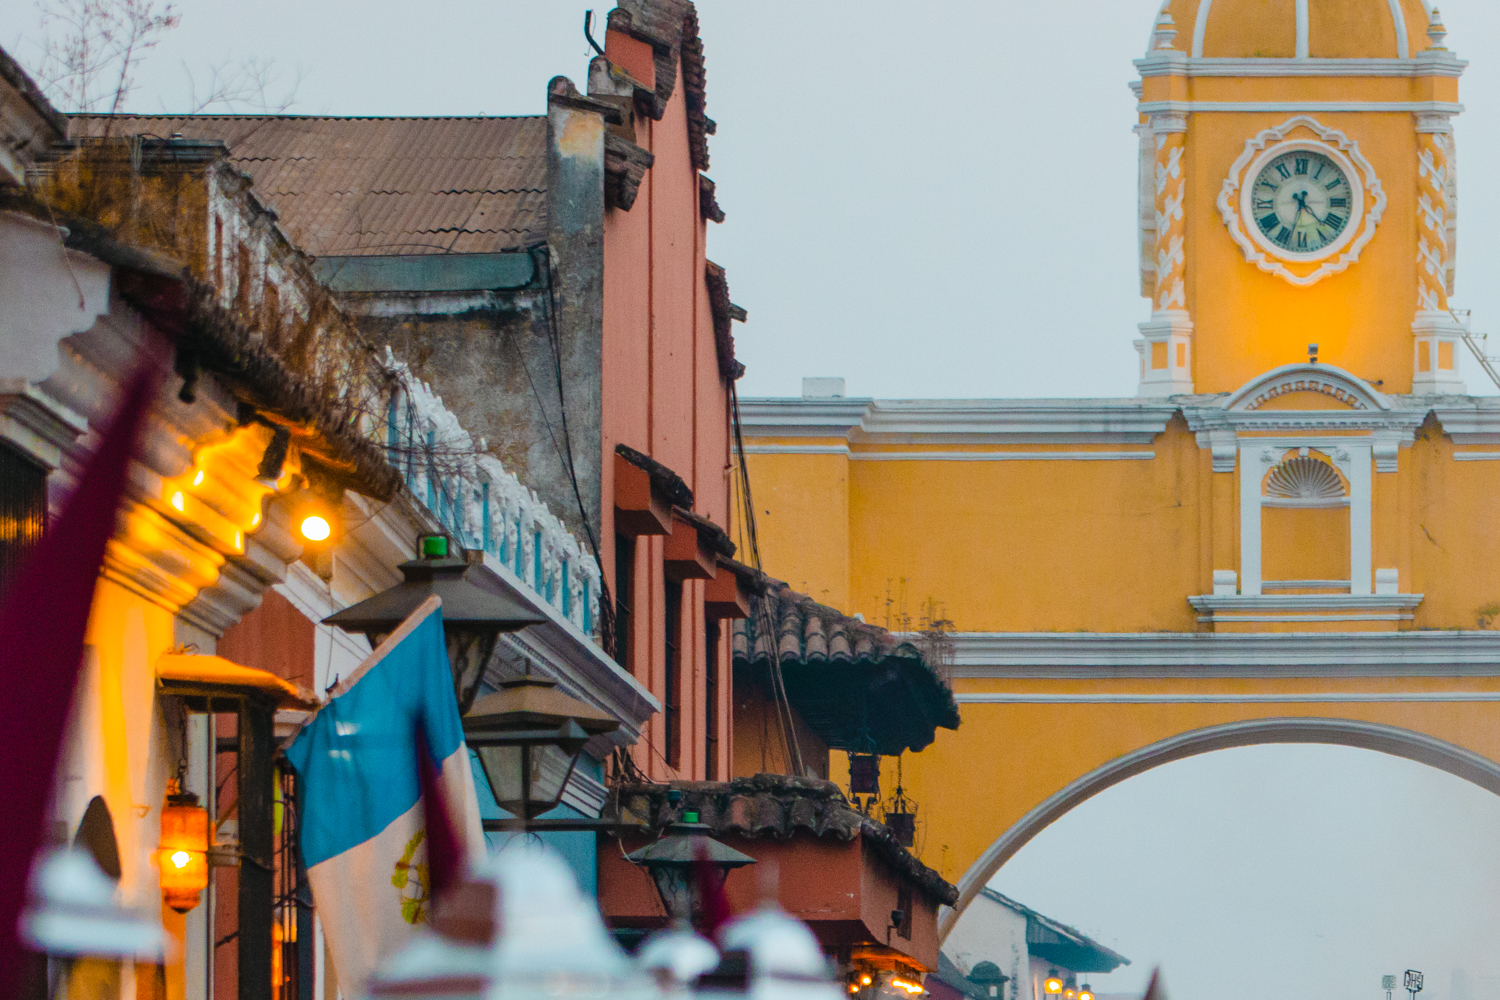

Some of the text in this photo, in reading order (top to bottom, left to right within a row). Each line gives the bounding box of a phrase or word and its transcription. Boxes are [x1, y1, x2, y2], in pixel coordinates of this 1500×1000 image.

[1276, 163, 1291, 181] XI
[1294, 158, 1309, 175] XII
[1313, 163, 1325, 180] I
[1261, 179, 1278, 192] X
[1325, 178, 1341, 190] II
[1257, 198, 1273, 209] IX
[1329, 198, 1346, 208] III
[1297, 231, 1307, 248] VI
[1316, 227, 1328, 242] V
